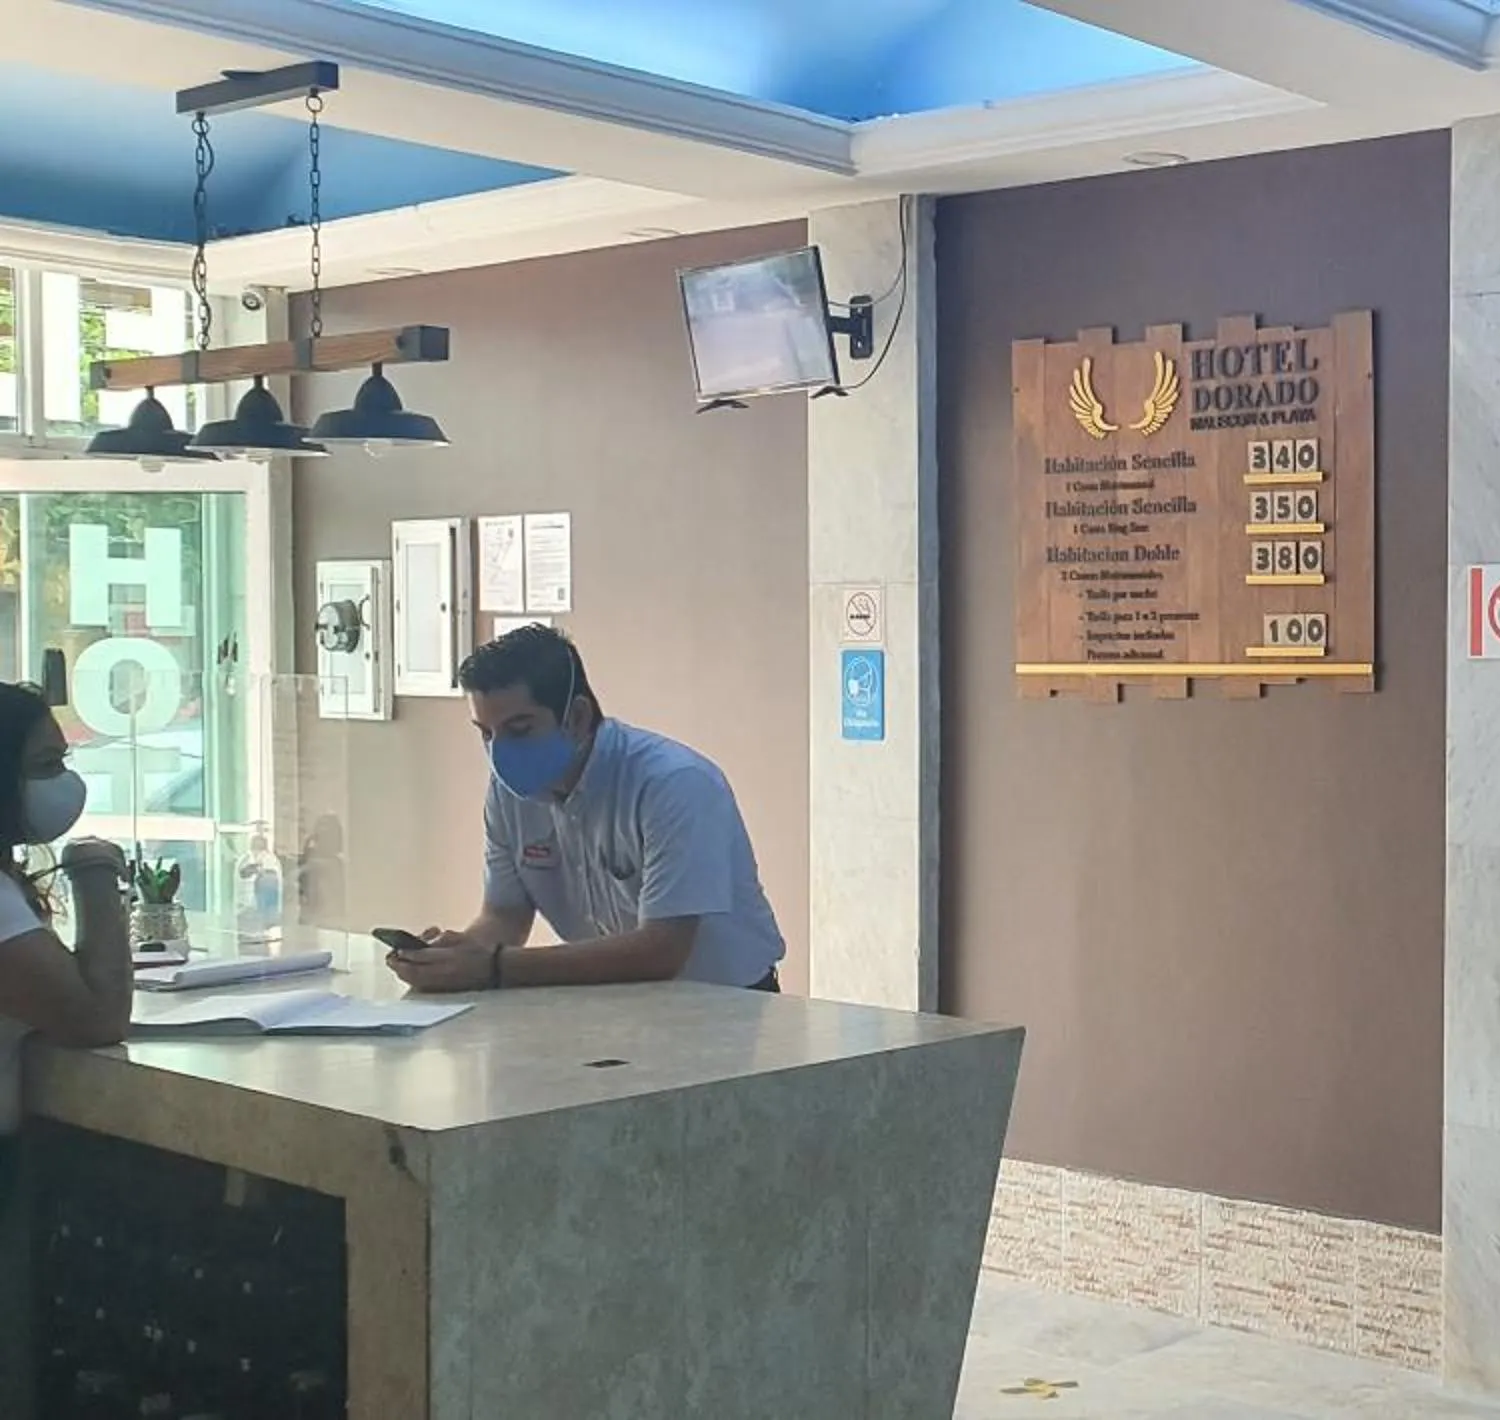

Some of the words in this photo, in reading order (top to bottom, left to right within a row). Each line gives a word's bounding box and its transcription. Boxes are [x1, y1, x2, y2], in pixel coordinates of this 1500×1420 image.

[1191, 337, 1319, 380] HOTEL
[1192, 376, 1319, 411] DORADO
[1131, 451, 1196, 470] Sencilla
[1252, 443, 1315, 470] 340
[1132, 496, 1197, 514] Sencilla
[1254, 495, 1315, 520] 350
[1134, 543, 1181, 561] Doble
[1255, 545, 1319, 570] 380
[1268, 618, 1324, 643] 100
